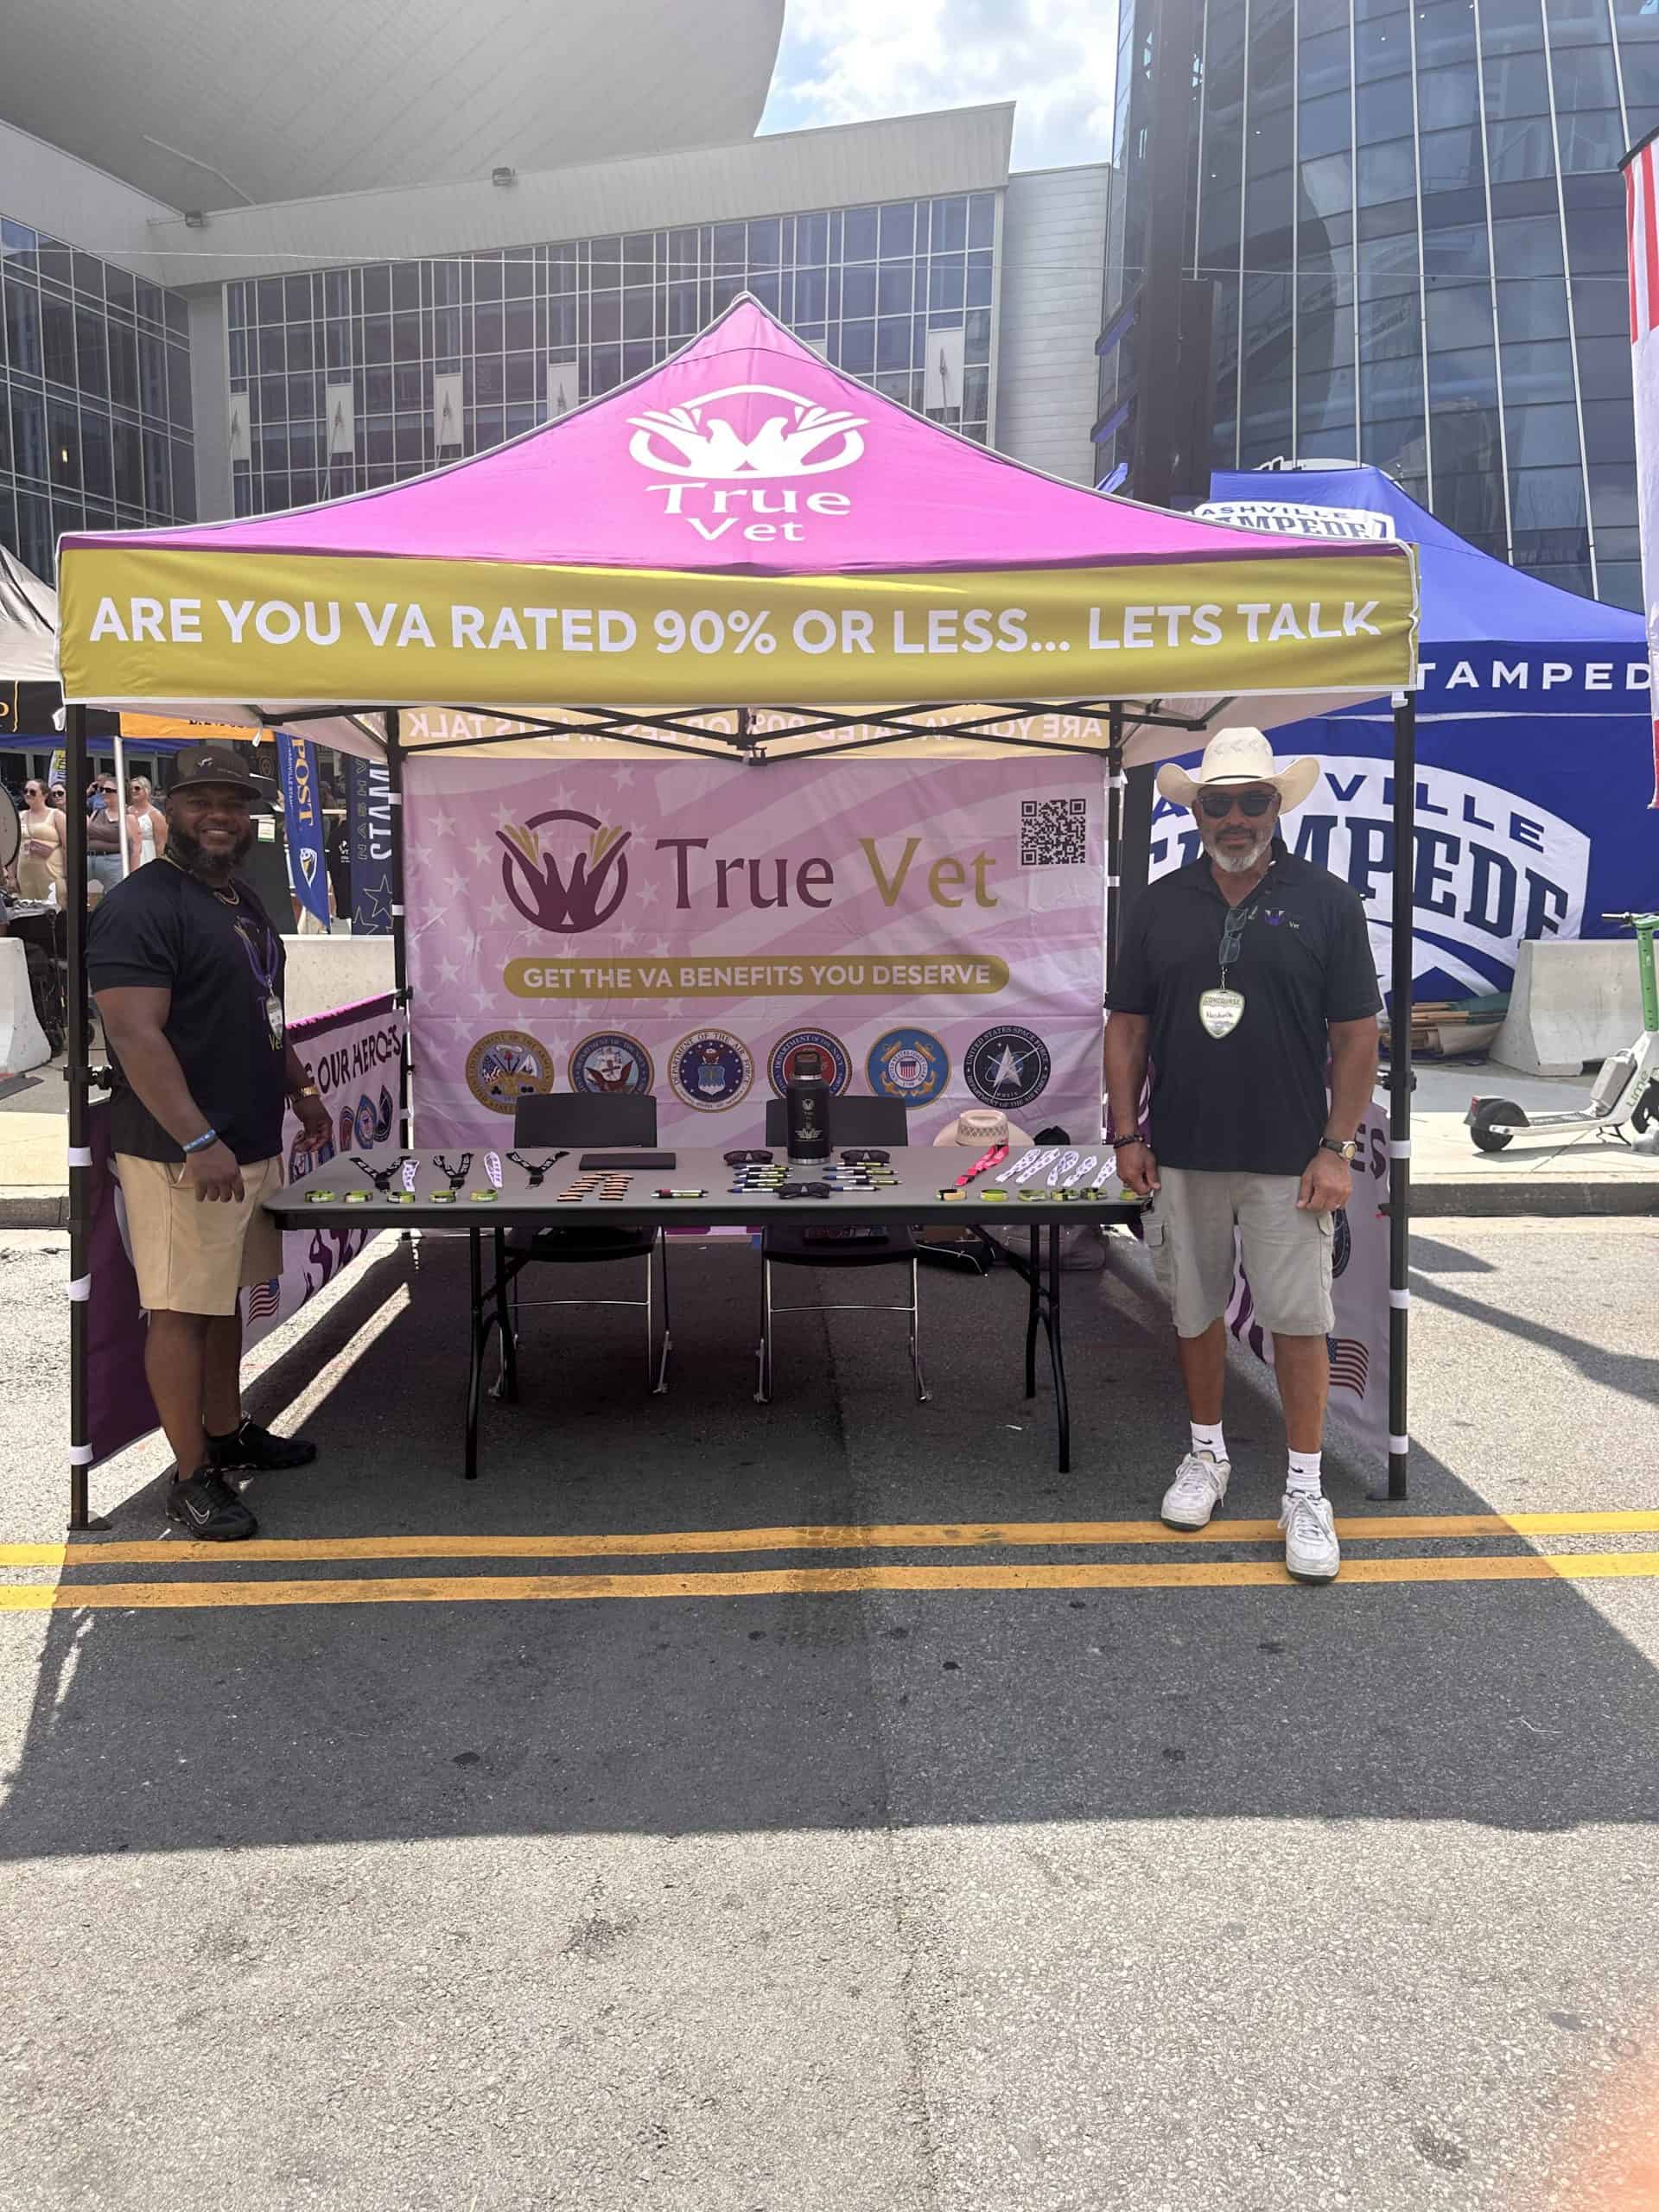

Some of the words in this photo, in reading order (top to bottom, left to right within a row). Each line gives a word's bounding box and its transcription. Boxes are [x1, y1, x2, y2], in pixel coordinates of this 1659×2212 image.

[644, 482, 851, 516] True
[684, 518, 806, 542] Vet
[89, 596, 202, 642] ARE
[216, 600, 341, 645] YOU
[355, 602, 435, 647] VA
[450, 605, 637, 652] RATED
[654, 609, 777, 654] 90%
[792, 609, 875, 654] OR
[893, 608, 1071, 654] LESS...
[1089, 604, 1224, 649] LETS
[1236, 601, 1382, 643] TALK
[655, 837, 835, 909] True
[859, 837, 999, 909] Vet
[524, 968, 575, 988] GET
[581, 968, 632, 988] THE
[636, 967, 673, 988] VA
[679, 966, 803, 988] BENEFITS
[810, 965, 864, 986] YOU
[872, 964, 990, 985] DESERVE
[317, 1048, 351, 1094] OUR
